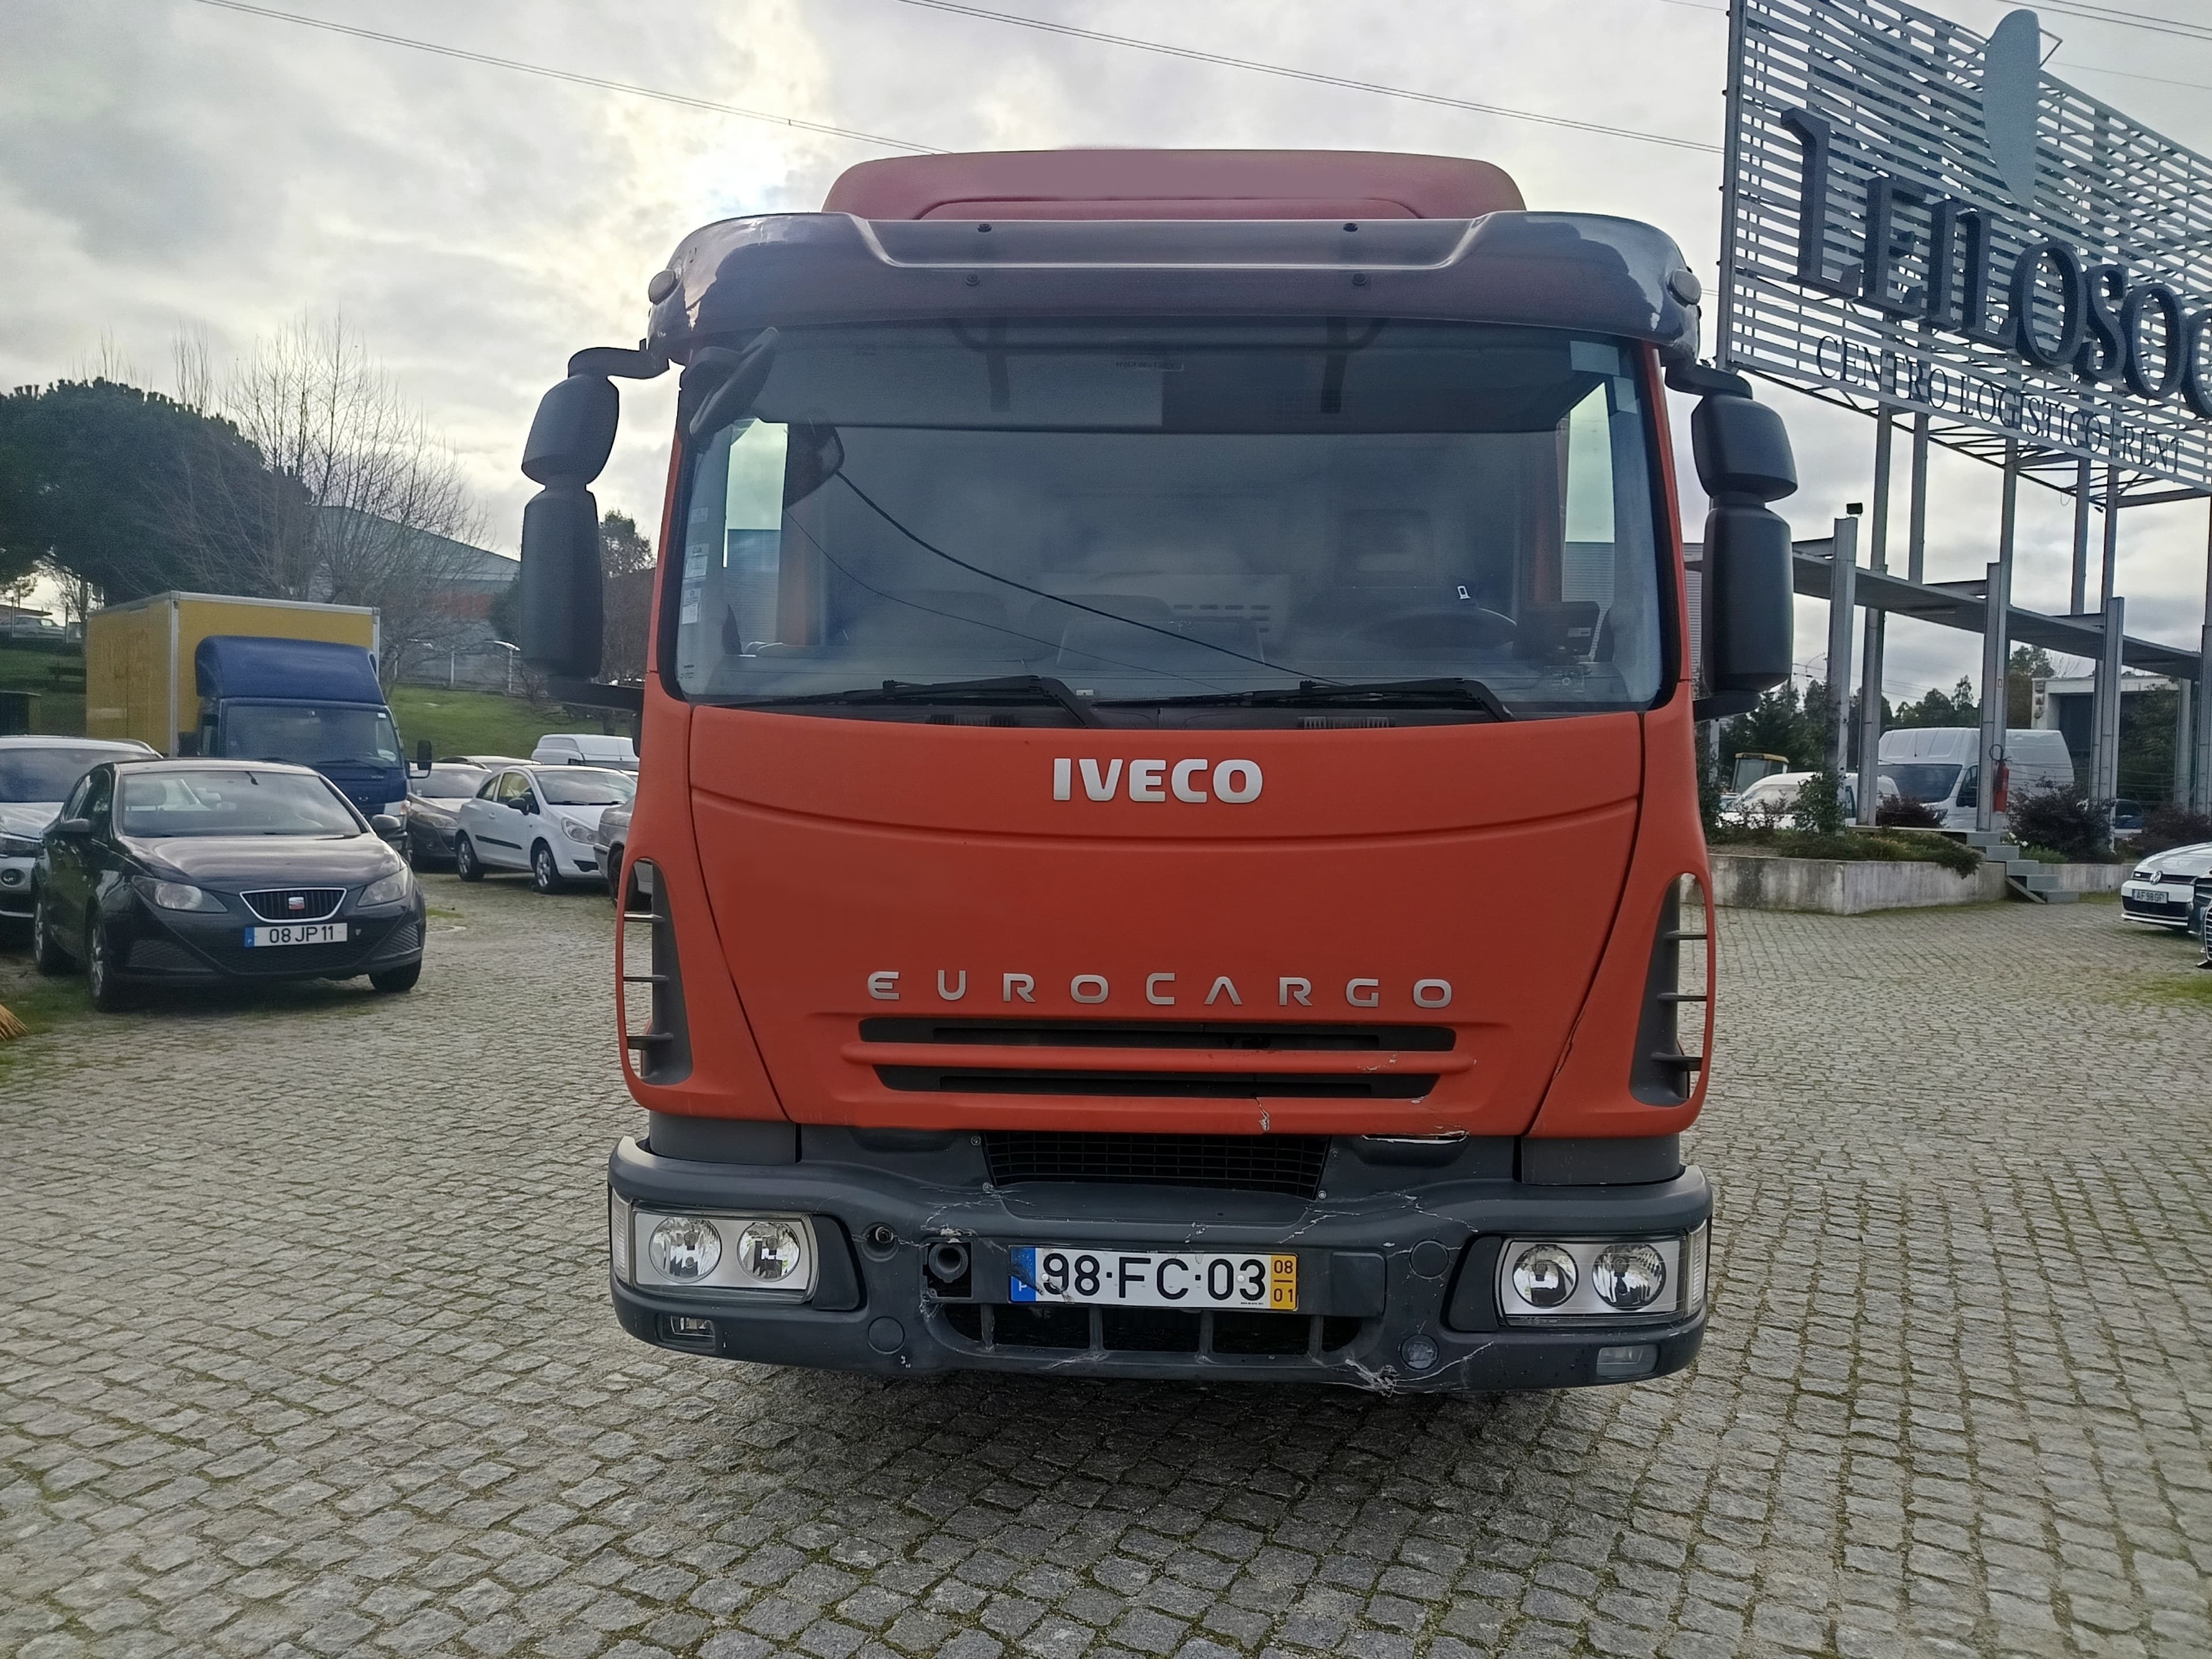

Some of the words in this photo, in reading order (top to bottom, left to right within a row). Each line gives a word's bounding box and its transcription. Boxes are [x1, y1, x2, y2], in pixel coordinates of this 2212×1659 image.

[1816, 335, 1948, 409] CENTRO
[1052, 757, 1264, 804] IVECO
[270, 928, 291, 943] 08
[295, 926, 318, 942] JP
[321, 925, 334, 941] 11
[867, 969, 1453, 1009] EUROCARGO
[1274, 1260, 1293, 1274] 08
[1274, 1288, 1293, 1302] 01
